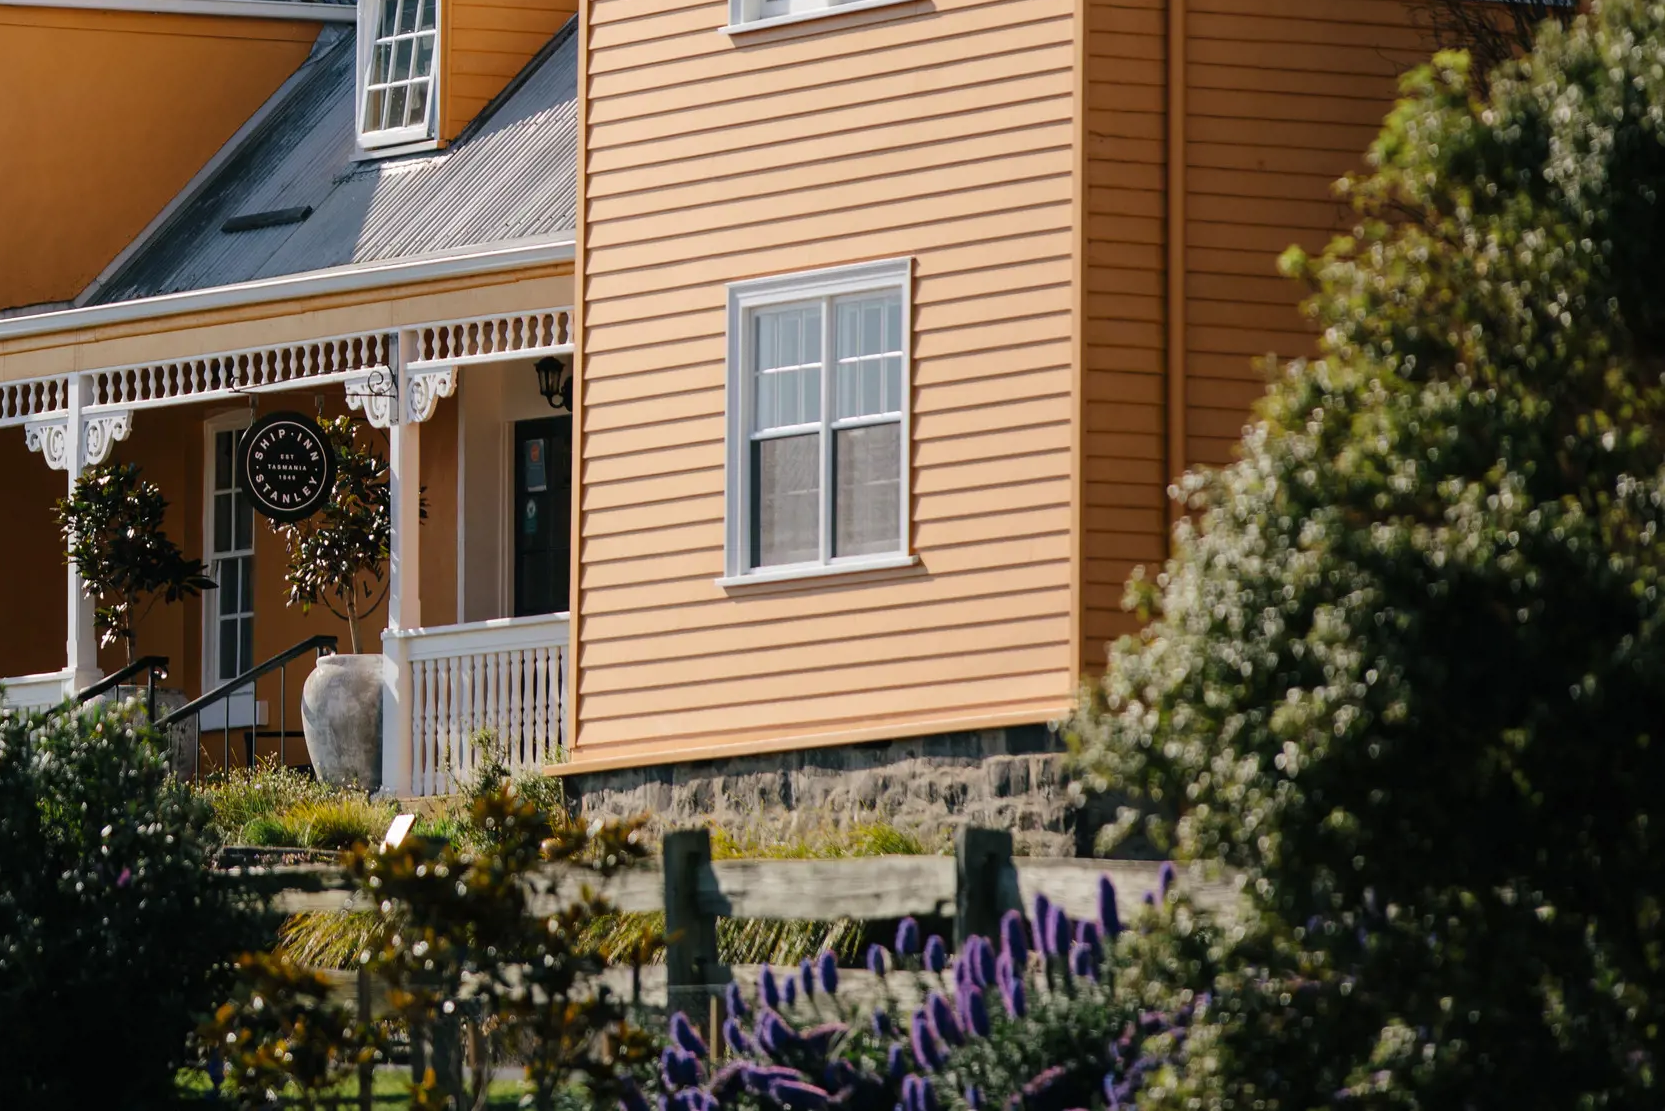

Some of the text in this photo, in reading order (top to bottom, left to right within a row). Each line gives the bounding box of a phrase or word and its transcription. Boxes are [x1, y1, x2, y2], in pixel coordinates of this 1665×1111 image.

[255, 429, 319, 461] SHIP INN
[267, 463, 307, 471] TASMANIA
[255, 473, 318, 504] STANLEY
